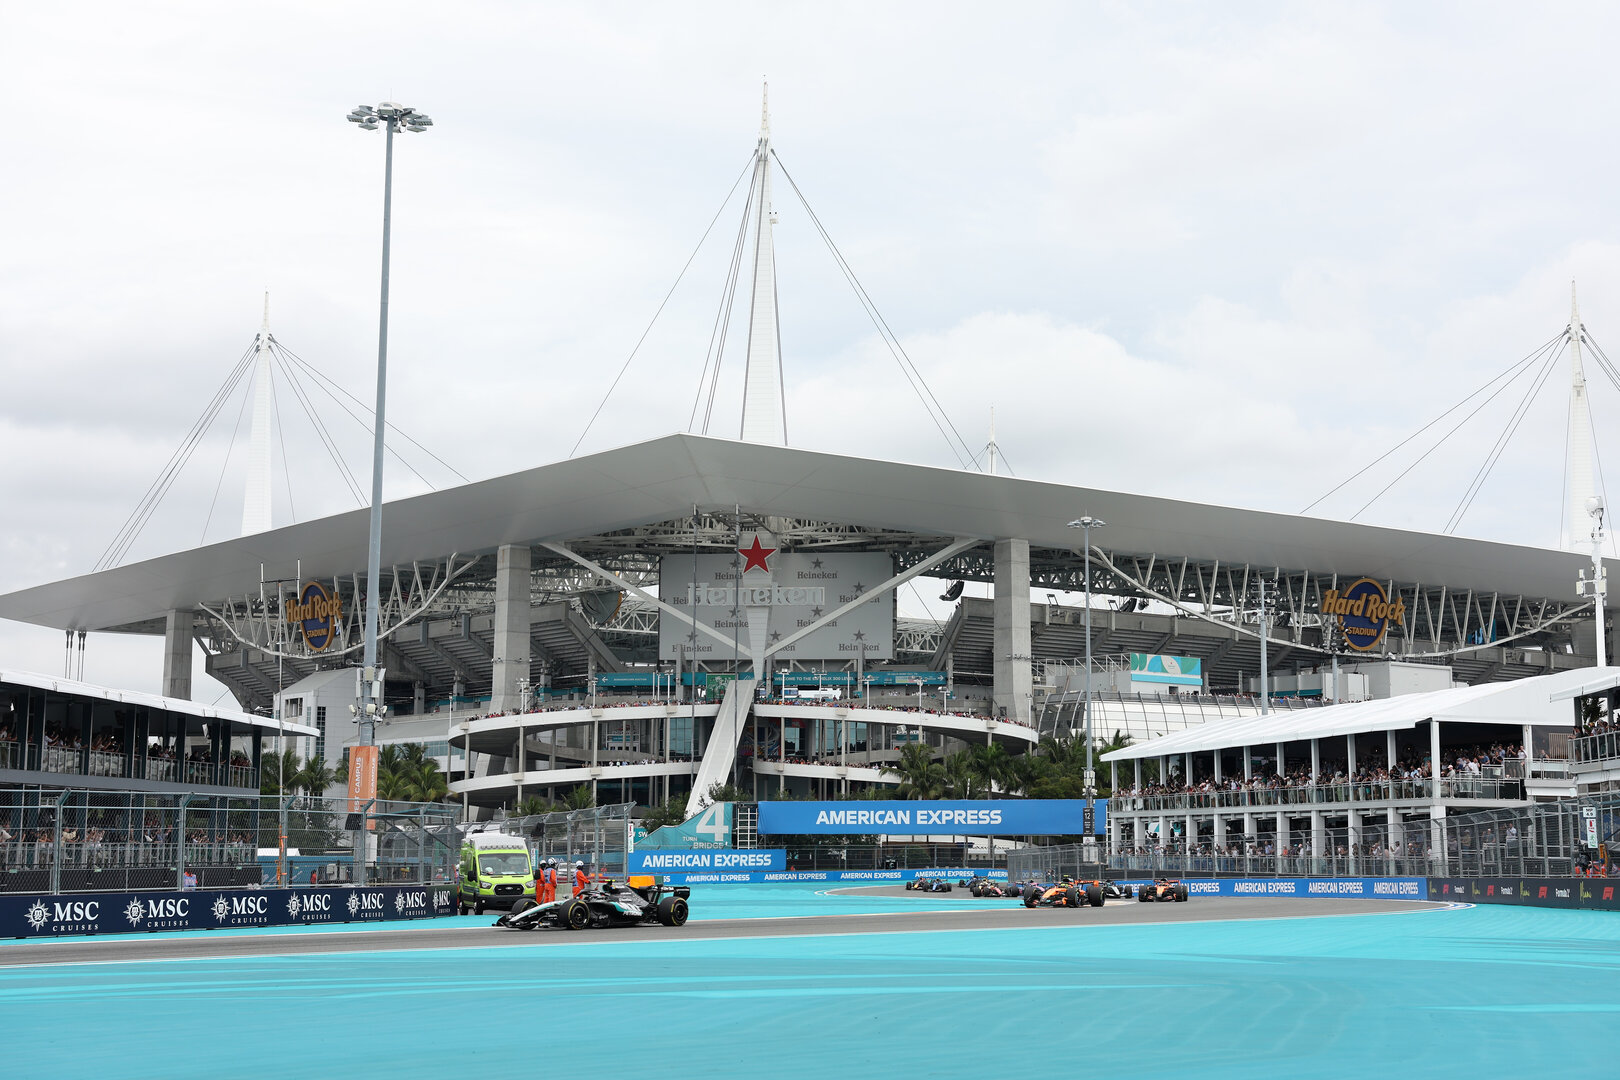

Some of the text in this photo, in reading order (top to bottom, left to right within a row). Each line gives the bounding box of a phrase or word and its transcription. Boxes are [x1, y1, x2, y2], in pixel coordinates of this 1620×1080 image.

[797, 571, 837, 580] Heineken
[688, 582, 824, 606] Heineken
[286, 592, 344, 623] Hard Rock
[1322, 590, 1406, 625] Hard Rock
[1348, 627, 1377, 636] STADIUM
[838, 643, 880, 651] Heinken
[696, 802, 728, 841] 4
[816, 810, 1002, 825] AMERICAN EXPRESS
[642, 853, 772, 867] AMERICAN EXPRESS
[1190, 883, 1220, 892] EXPRESS
[1234, 882, 1295, 893] AMERICAN EXPRESS
[1308, 882, 1363, 893] AMERICAN EXPRESS
[1374, 882, 1418, 894] AMERICAN EXPRESS
[232, 896, 267, 914] MSC
[303, 894, 331, 912] MSC
[361, 893, 384, 909] MSC
[406, 892, 426, 908] MSC
[438, 891, 450, 906] MSC
[53, 902, 99, 922] MSC
[148, 899, 189, 918] MSC
